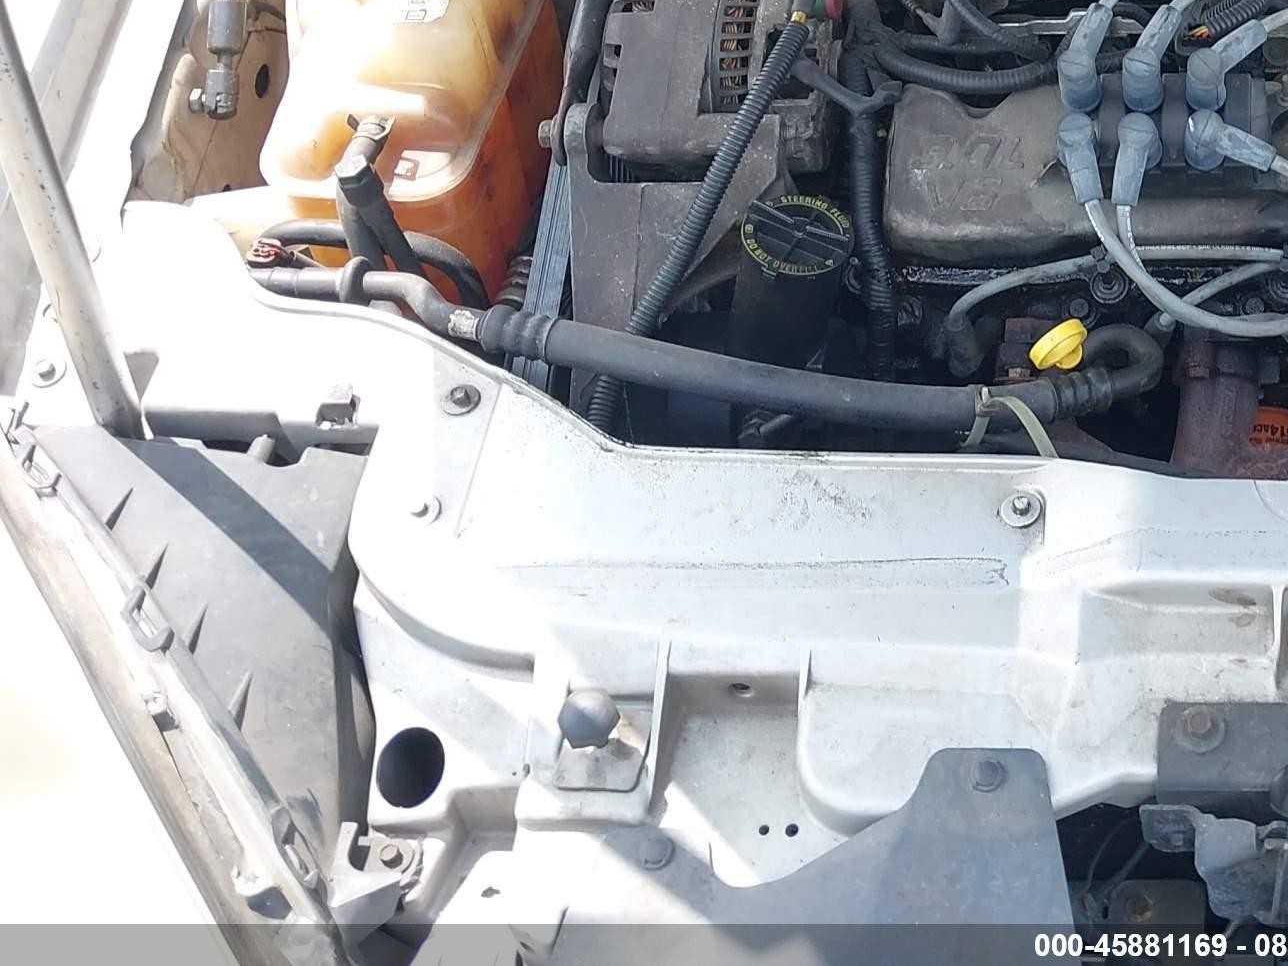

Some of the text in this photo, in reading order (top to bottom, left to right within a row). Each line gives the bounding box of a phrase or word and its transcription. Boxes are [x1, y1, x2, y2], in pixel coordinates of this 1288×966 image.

[780, 194, 850, 229] STEERING FLUID
[755, 248, 773, 266] NOT
